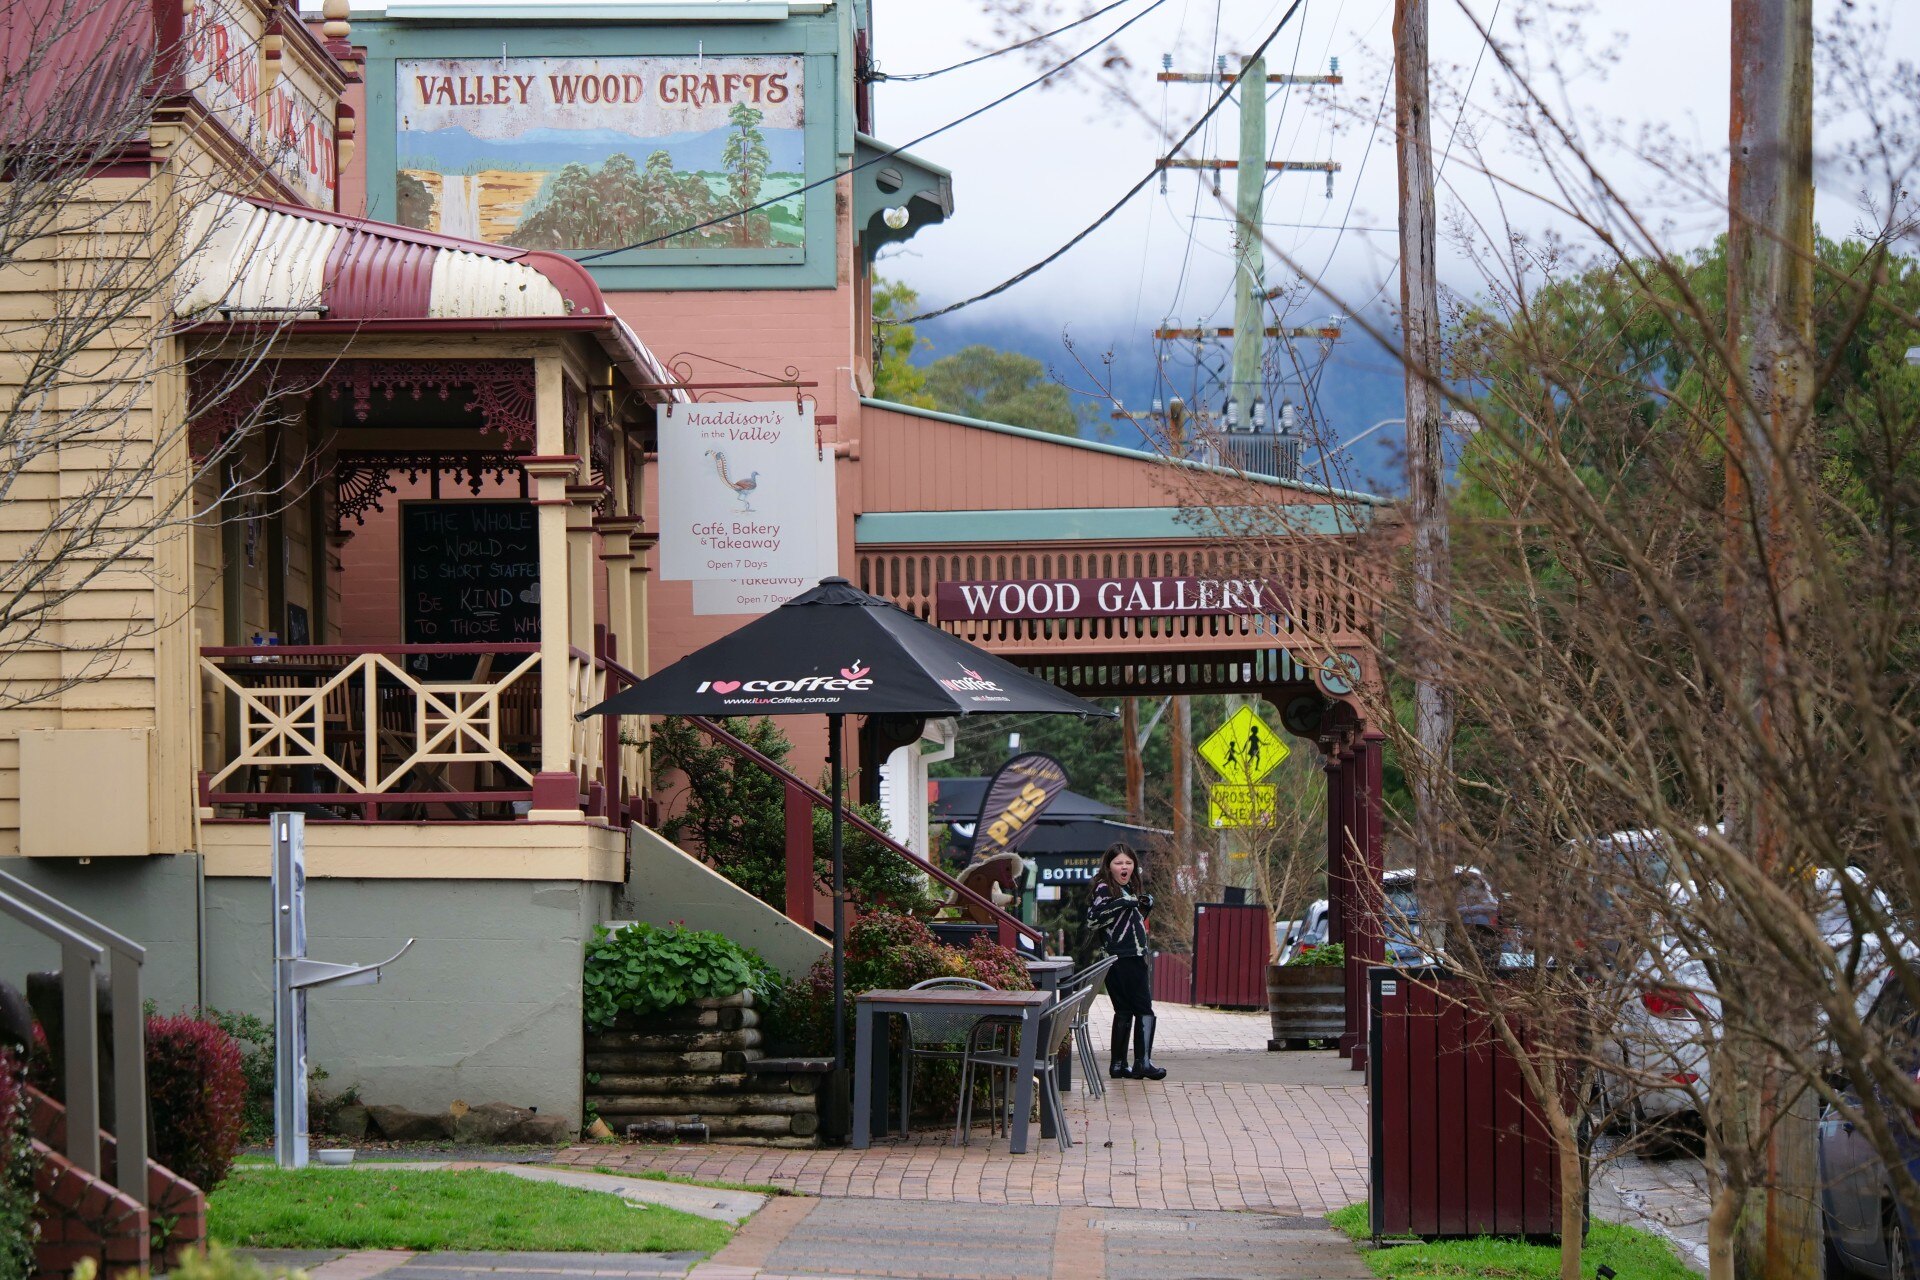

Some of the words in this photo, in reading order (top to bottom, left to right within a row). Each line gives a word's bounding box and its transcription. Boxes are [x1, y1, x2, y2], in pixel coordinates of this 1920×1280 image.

[416, 74, 535, 106] VALLEY
[548, 73, 644, 105] WOOD
[687, 410, 784, 426] Maddison's
[701, 430, 709, 438] in
[711, 430, 725, 438] the
[728, 427, 781, 444] Valley
[413, 511, 459, 534] THE
[472, 508, 532, 533] WHOLE
[692, 522, 728, 537] Café,
[732, 522, 780, 538] Bakery
[445, 535, 503, 563] WORLD
[700, 538, 708, 546] &
[709, 537, 781, 551] Takeaway
[413, 564, 429, 580] IS
[439, 563, 483, 580] SHORT
[707, 559, 733, 570] Open
[735, 559, 742, 568] 7
[744, 559, 768, 571] Days
[418, 592, 444, 613] BE
[460, 587, 514, 613] KIND
[737, 595, 761, 605] Open
[763, 594, 769, 603] 7
[959, 583, 1081, 615] WOOD
[1097, 578, 1269, 613] GALLERY
[414, 619, 438, 635] TO
[450, 618, 501, 636] THOSE
[742, 676, 874, 693] coffee
[986, 782, 1047, 847] PIES
